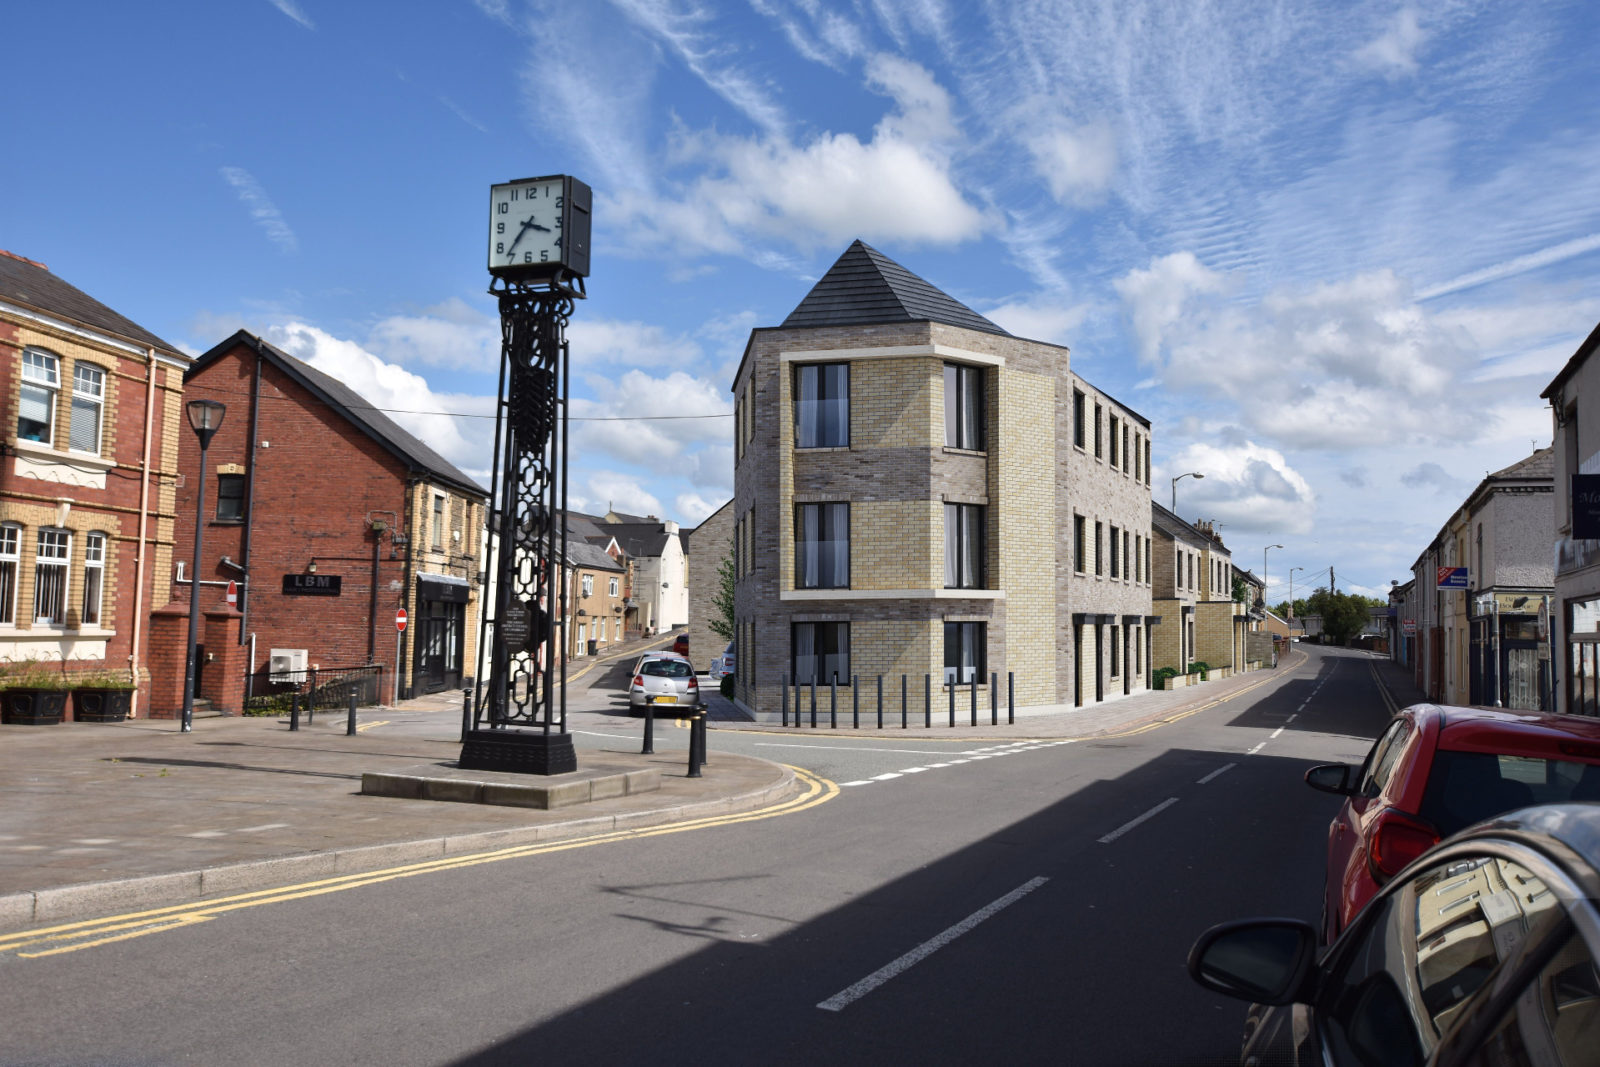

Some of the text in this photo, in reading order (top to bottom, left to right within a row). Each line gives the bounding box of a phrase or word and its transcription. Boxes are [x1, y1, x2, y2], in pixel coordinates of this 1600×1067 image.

[511, 190, 518, 201] 11
[526, 188, 537, 200] 12
[546, 186, 549, 198] 1
[498, 202, 508, 214] 10
[556, 197, 563, 208] 2
[555, 216, 562, 228] 3
[497, 222, 504, 234] 9
[496, 243, 504, 254] 8
[507, 253, 516, 264] 7
[525, 252, 532, 263] 6
[540, 250, 548, 262] 5
[295, 576, 330, 587] LBM
